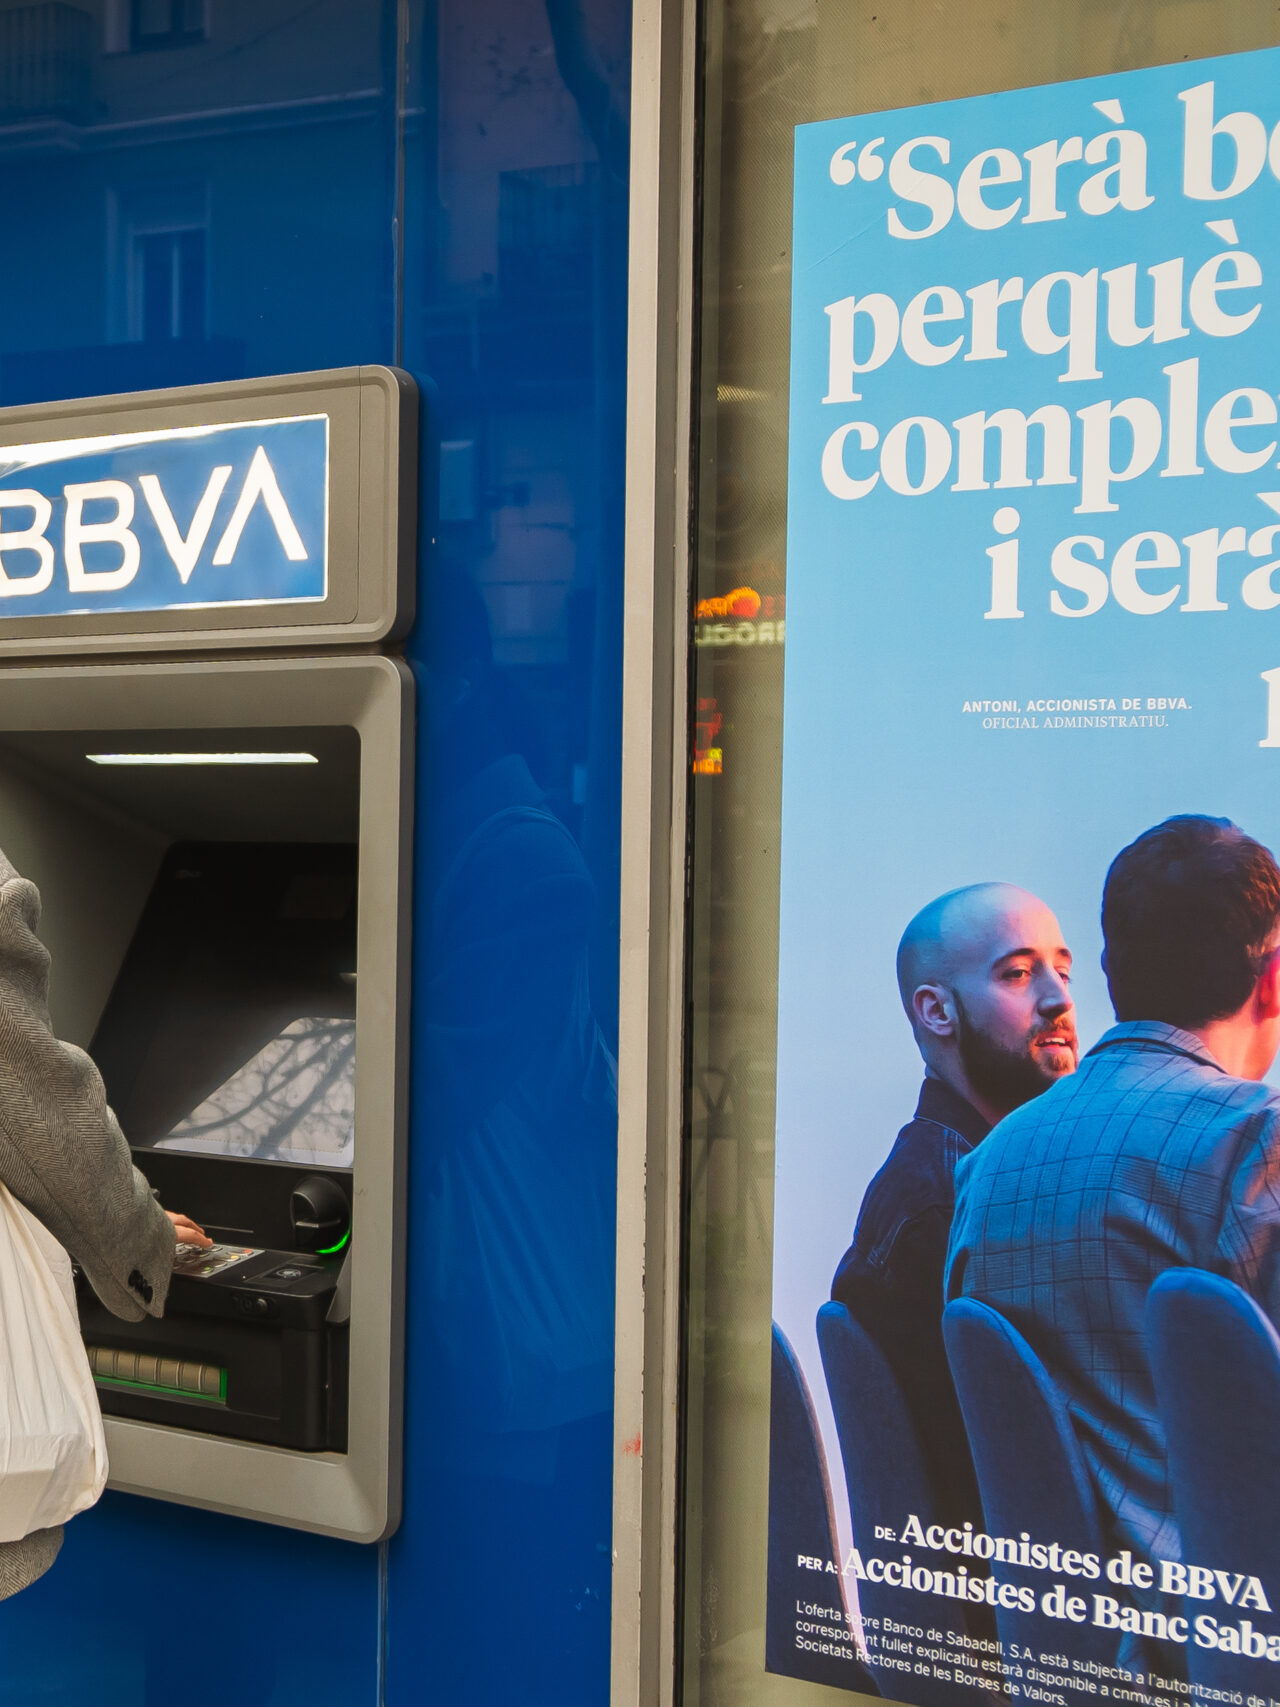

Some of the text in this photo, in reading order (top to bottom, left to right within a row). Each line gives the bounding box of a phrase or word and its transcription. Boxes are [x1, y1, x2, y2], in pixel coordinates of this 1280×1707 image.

[829, 80, 1280, 241] “Serà b
[822, 219, 1264, 405] perquè
[821, 357, 1280, 515] comple
[984, 506, 1025, 620] i
[962, 697, 1193, 714] ANTONI, ACCIONISTA DE BBVA.
[982, 715, 1169, 730] OFICIAL ADMINISTRATIU.
[797, 1554, 824, 1572] PER
[841, 1548, 1035, 1614] Accionistes
[1041, 1584, 1087, 1623] de
[1092, 1594, 1189, 1643] Banc
[874, 1514, 1273, 1613] DE: Accionistes de BBVA
[795, 1635, 1069, 1707] Societats Rectores de les Borses de Valors.
[881, 1636, 914, 1655] fullet
[916, 1645, 979, 1668] explicatiu
[981, 1659, 1023, 1678] estarà
[1026, 1667, 1097, 1694] disponible
[1100, 1684, 1109, 1697] a
[883, 1617, 924, 1638] Banco
[926, 1628, 943, 1643] de
[1009, 1643, 1037, 1663] S.A.
[1039, 1652, 1069, 1669] està
[1072, 1658, 1132, 1682] subjecta
[1135, 1673, 1145, 1684] a
[1148, 1672, 1243, 1704] l'autorització
[1246, 1694, 1266, 1707] de
